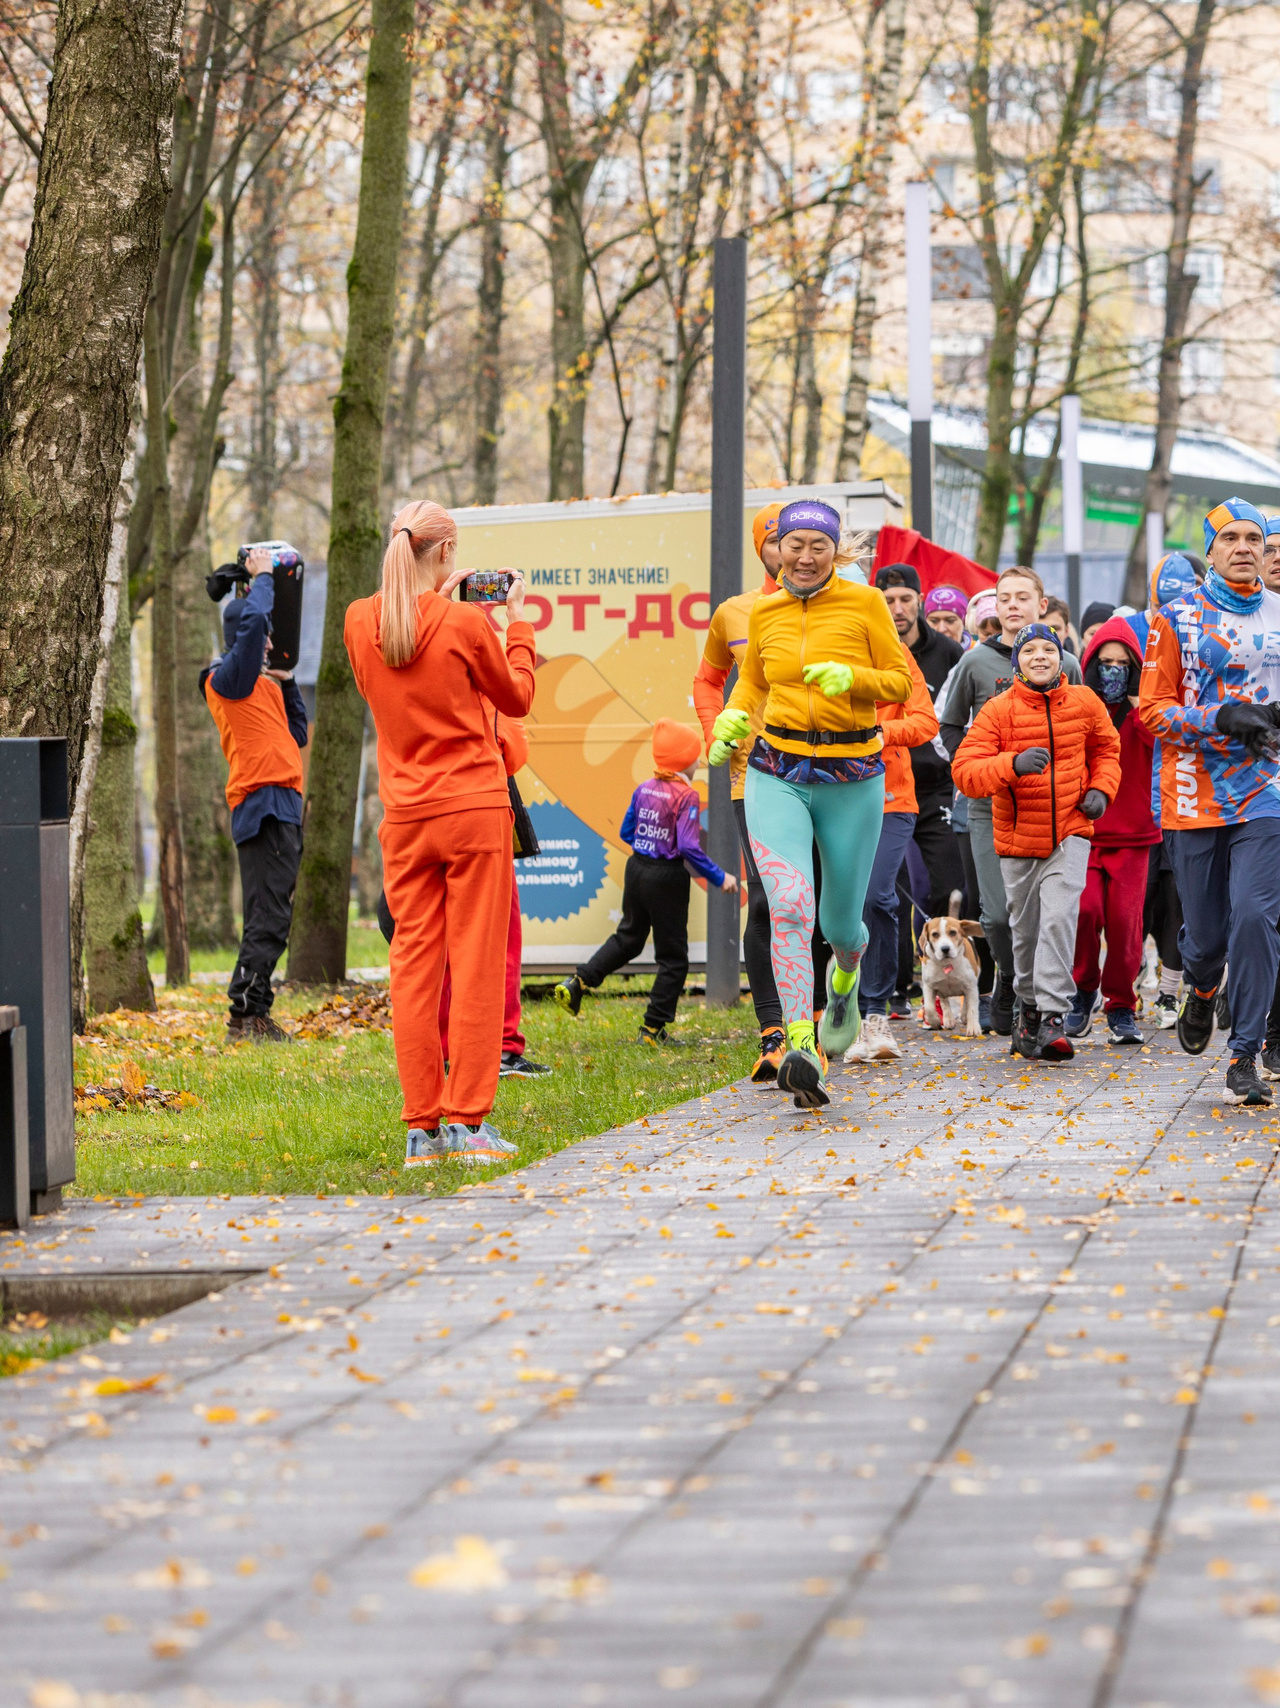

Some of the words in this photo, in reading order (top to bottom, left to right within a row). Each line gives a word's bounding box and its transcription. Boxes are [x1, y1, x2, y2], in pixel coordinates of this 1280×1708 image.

[531, 568, 582, 585] ИМЕЕТ
[588, 567, 670, 585] ЗНАЧЕНИЕ!
[480, 592, 711, 639] ОТ-ДО
[1203, 647, 1212, 666] club
[1176, 752, 1199, 819] RUN
[636, 823, 671, 842] ОБНЯ,
[538, 839, 580, 850] емись
[523, 856, 578, 870] самому
[515, 870, 584, 887] ольшому!
